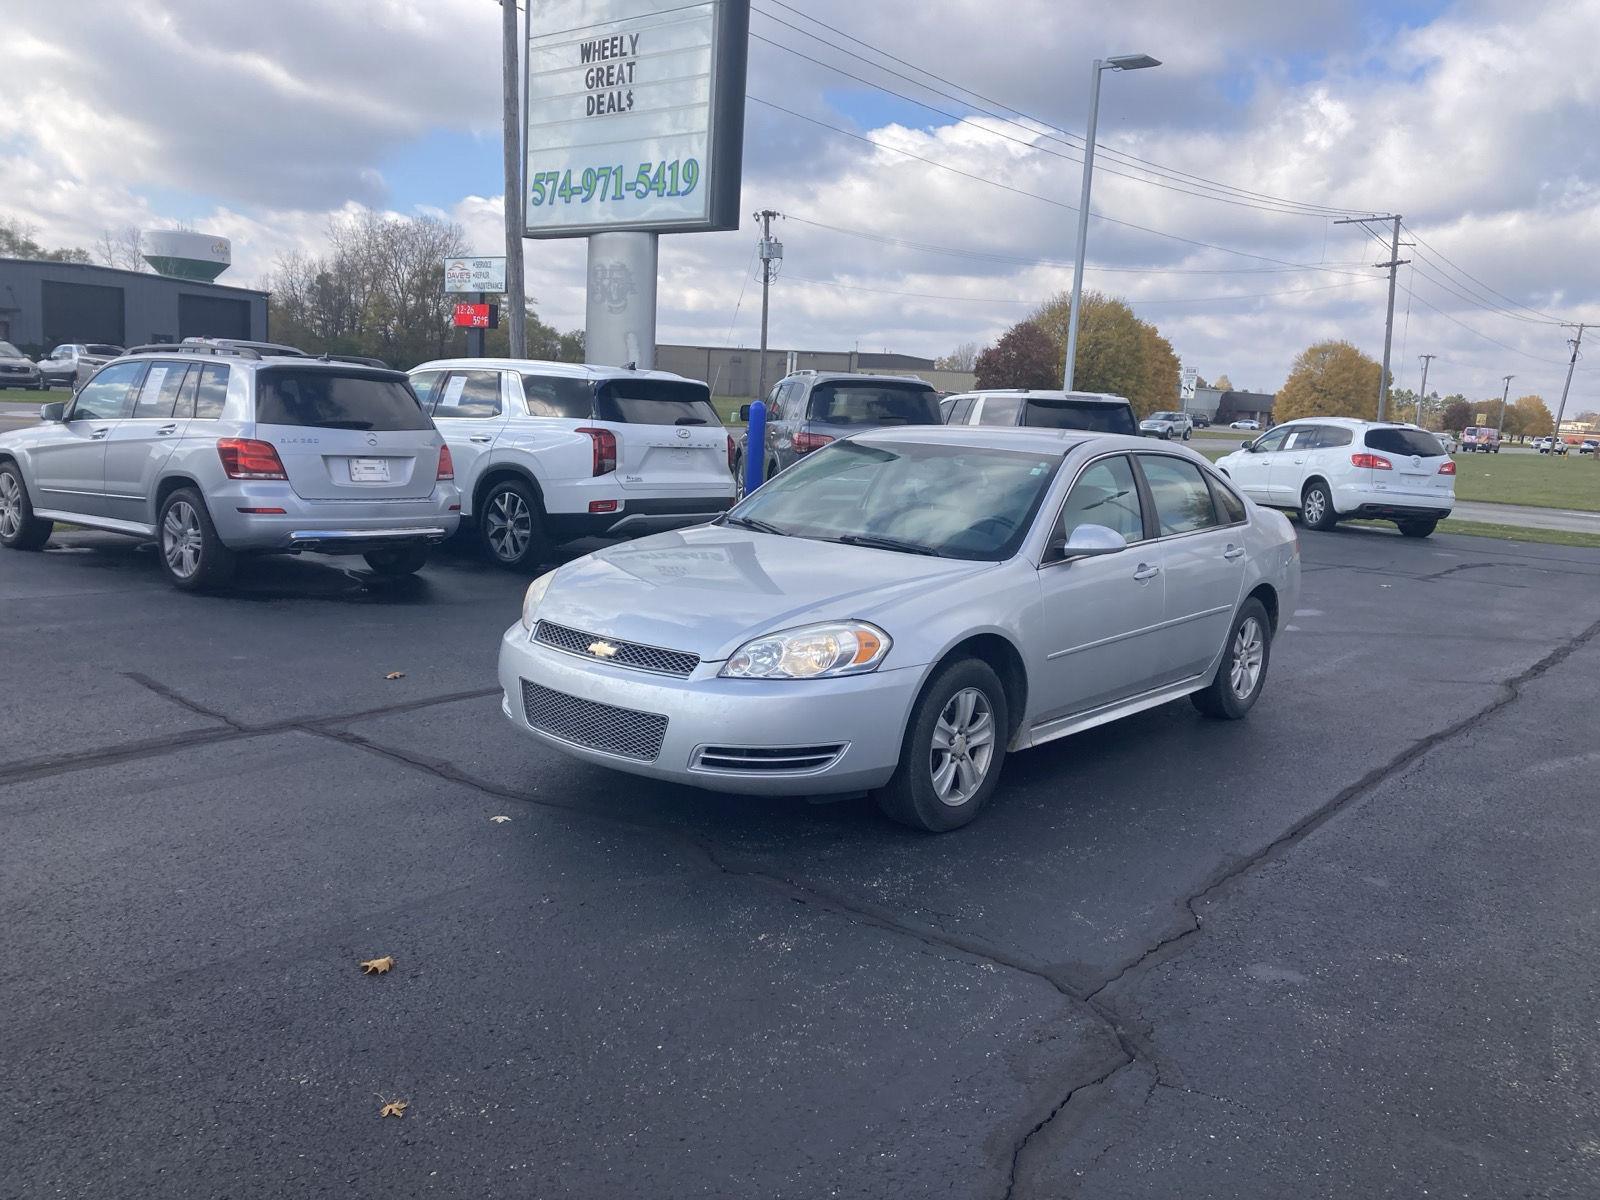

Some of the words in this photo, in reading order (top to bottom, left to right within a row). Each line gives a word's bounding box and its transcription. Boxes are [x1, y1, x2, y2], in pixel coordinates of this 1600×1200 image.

[580, 33, 640, 64] WHEELY
[585, 61, 636, 89] GREAT
[586, 90, 634, 116] DEAL$
[532, 158, 699, 206] 574-971-5419
